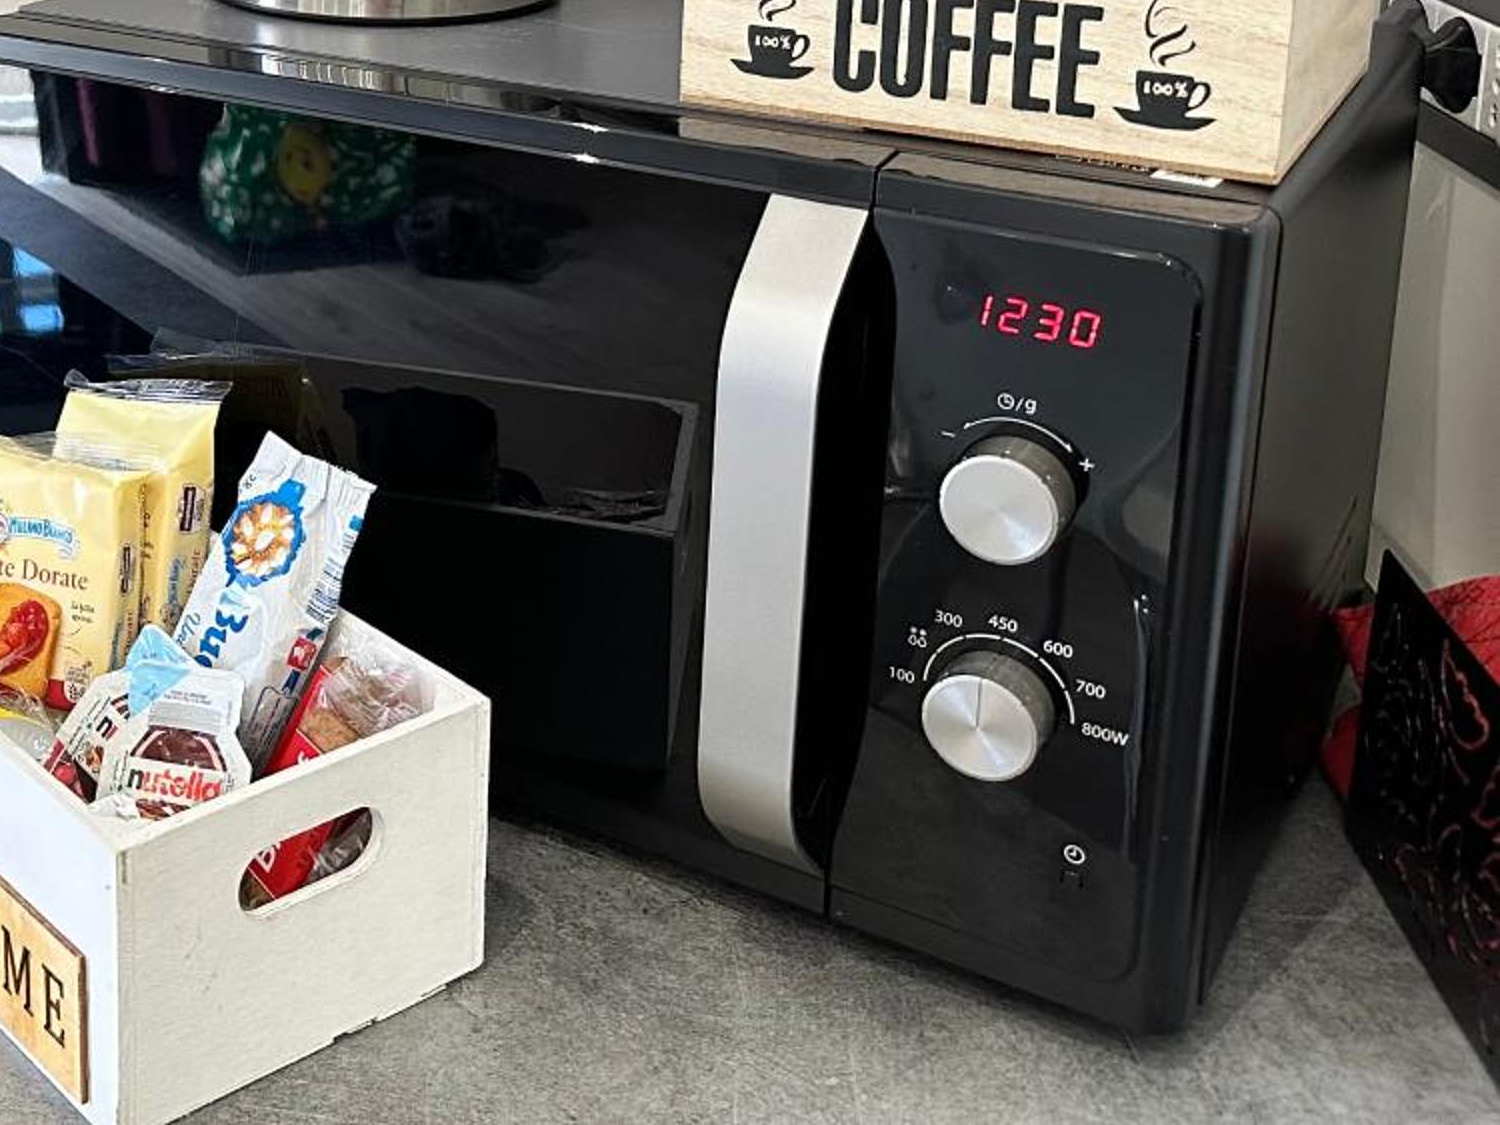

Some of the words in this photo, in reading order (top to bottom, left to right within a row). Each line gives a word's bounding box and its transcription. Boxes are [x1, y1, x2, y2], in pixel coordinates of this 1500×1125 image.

[755, 34, 791, 50] 100%
[1143, 80, 1189, 98] 100%
[980, 295, 1102, 348] 1230
[22, 558, 90, 591] Dorate
[934, 610, 963, 628] 300
[988, 614, 1019, 633] 450
[1043, 640, 1073, 659] 600
[889, 666, 915, 684] 100
[1076, 679, 1106, 699] 700
[1081, 722, 1129, 747] 800W
[128, 767, 223, 802] nutella
